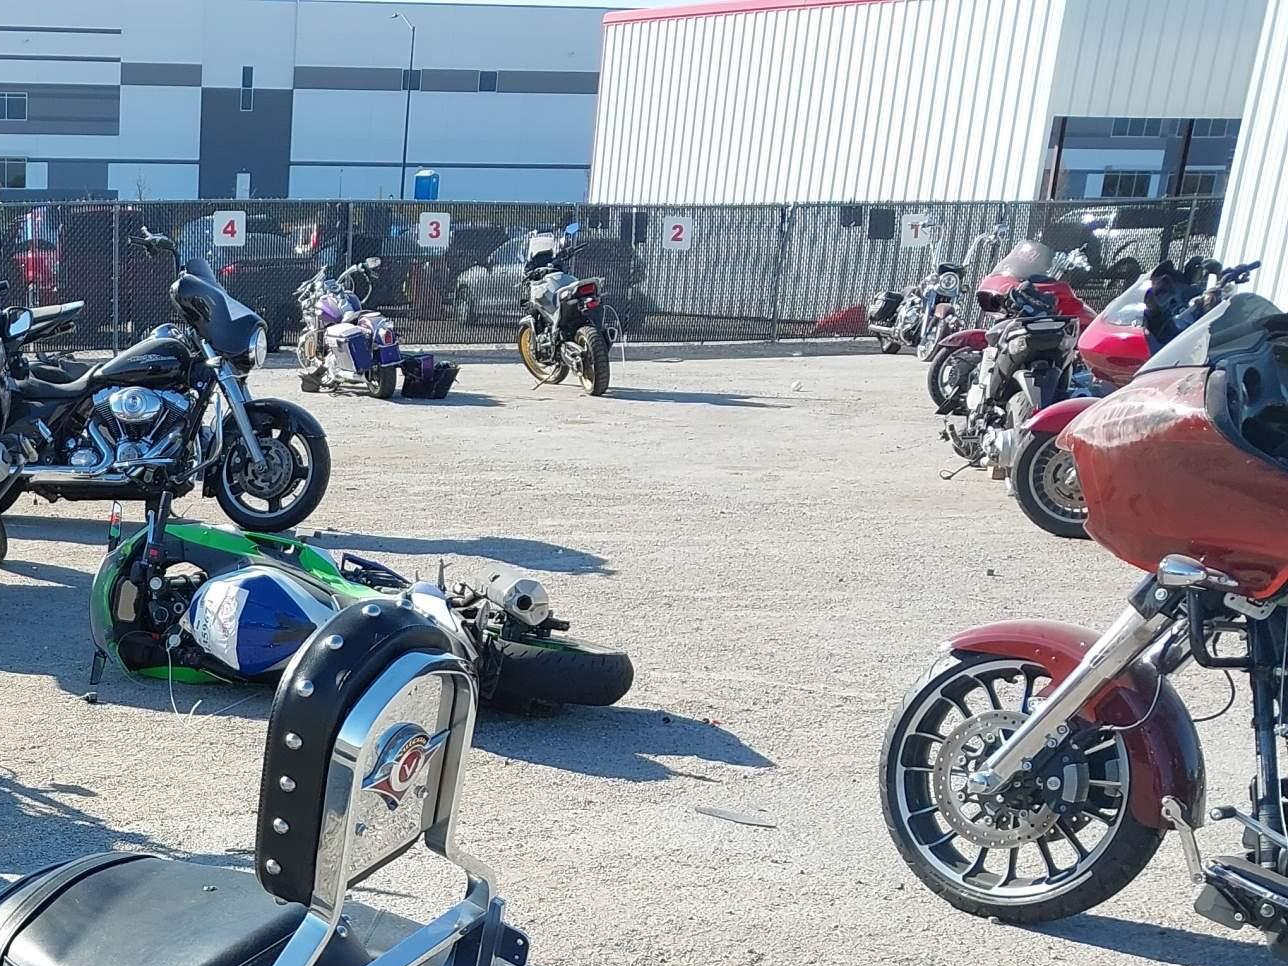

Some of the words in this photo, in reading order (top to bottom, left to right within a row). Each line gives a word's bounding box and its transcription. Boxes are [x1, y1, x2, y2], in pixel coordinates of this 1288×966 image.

[222, 219, 237, 238] 4
[428, 220, 441, 239] 3
[671, 224, 684, 242] 2
